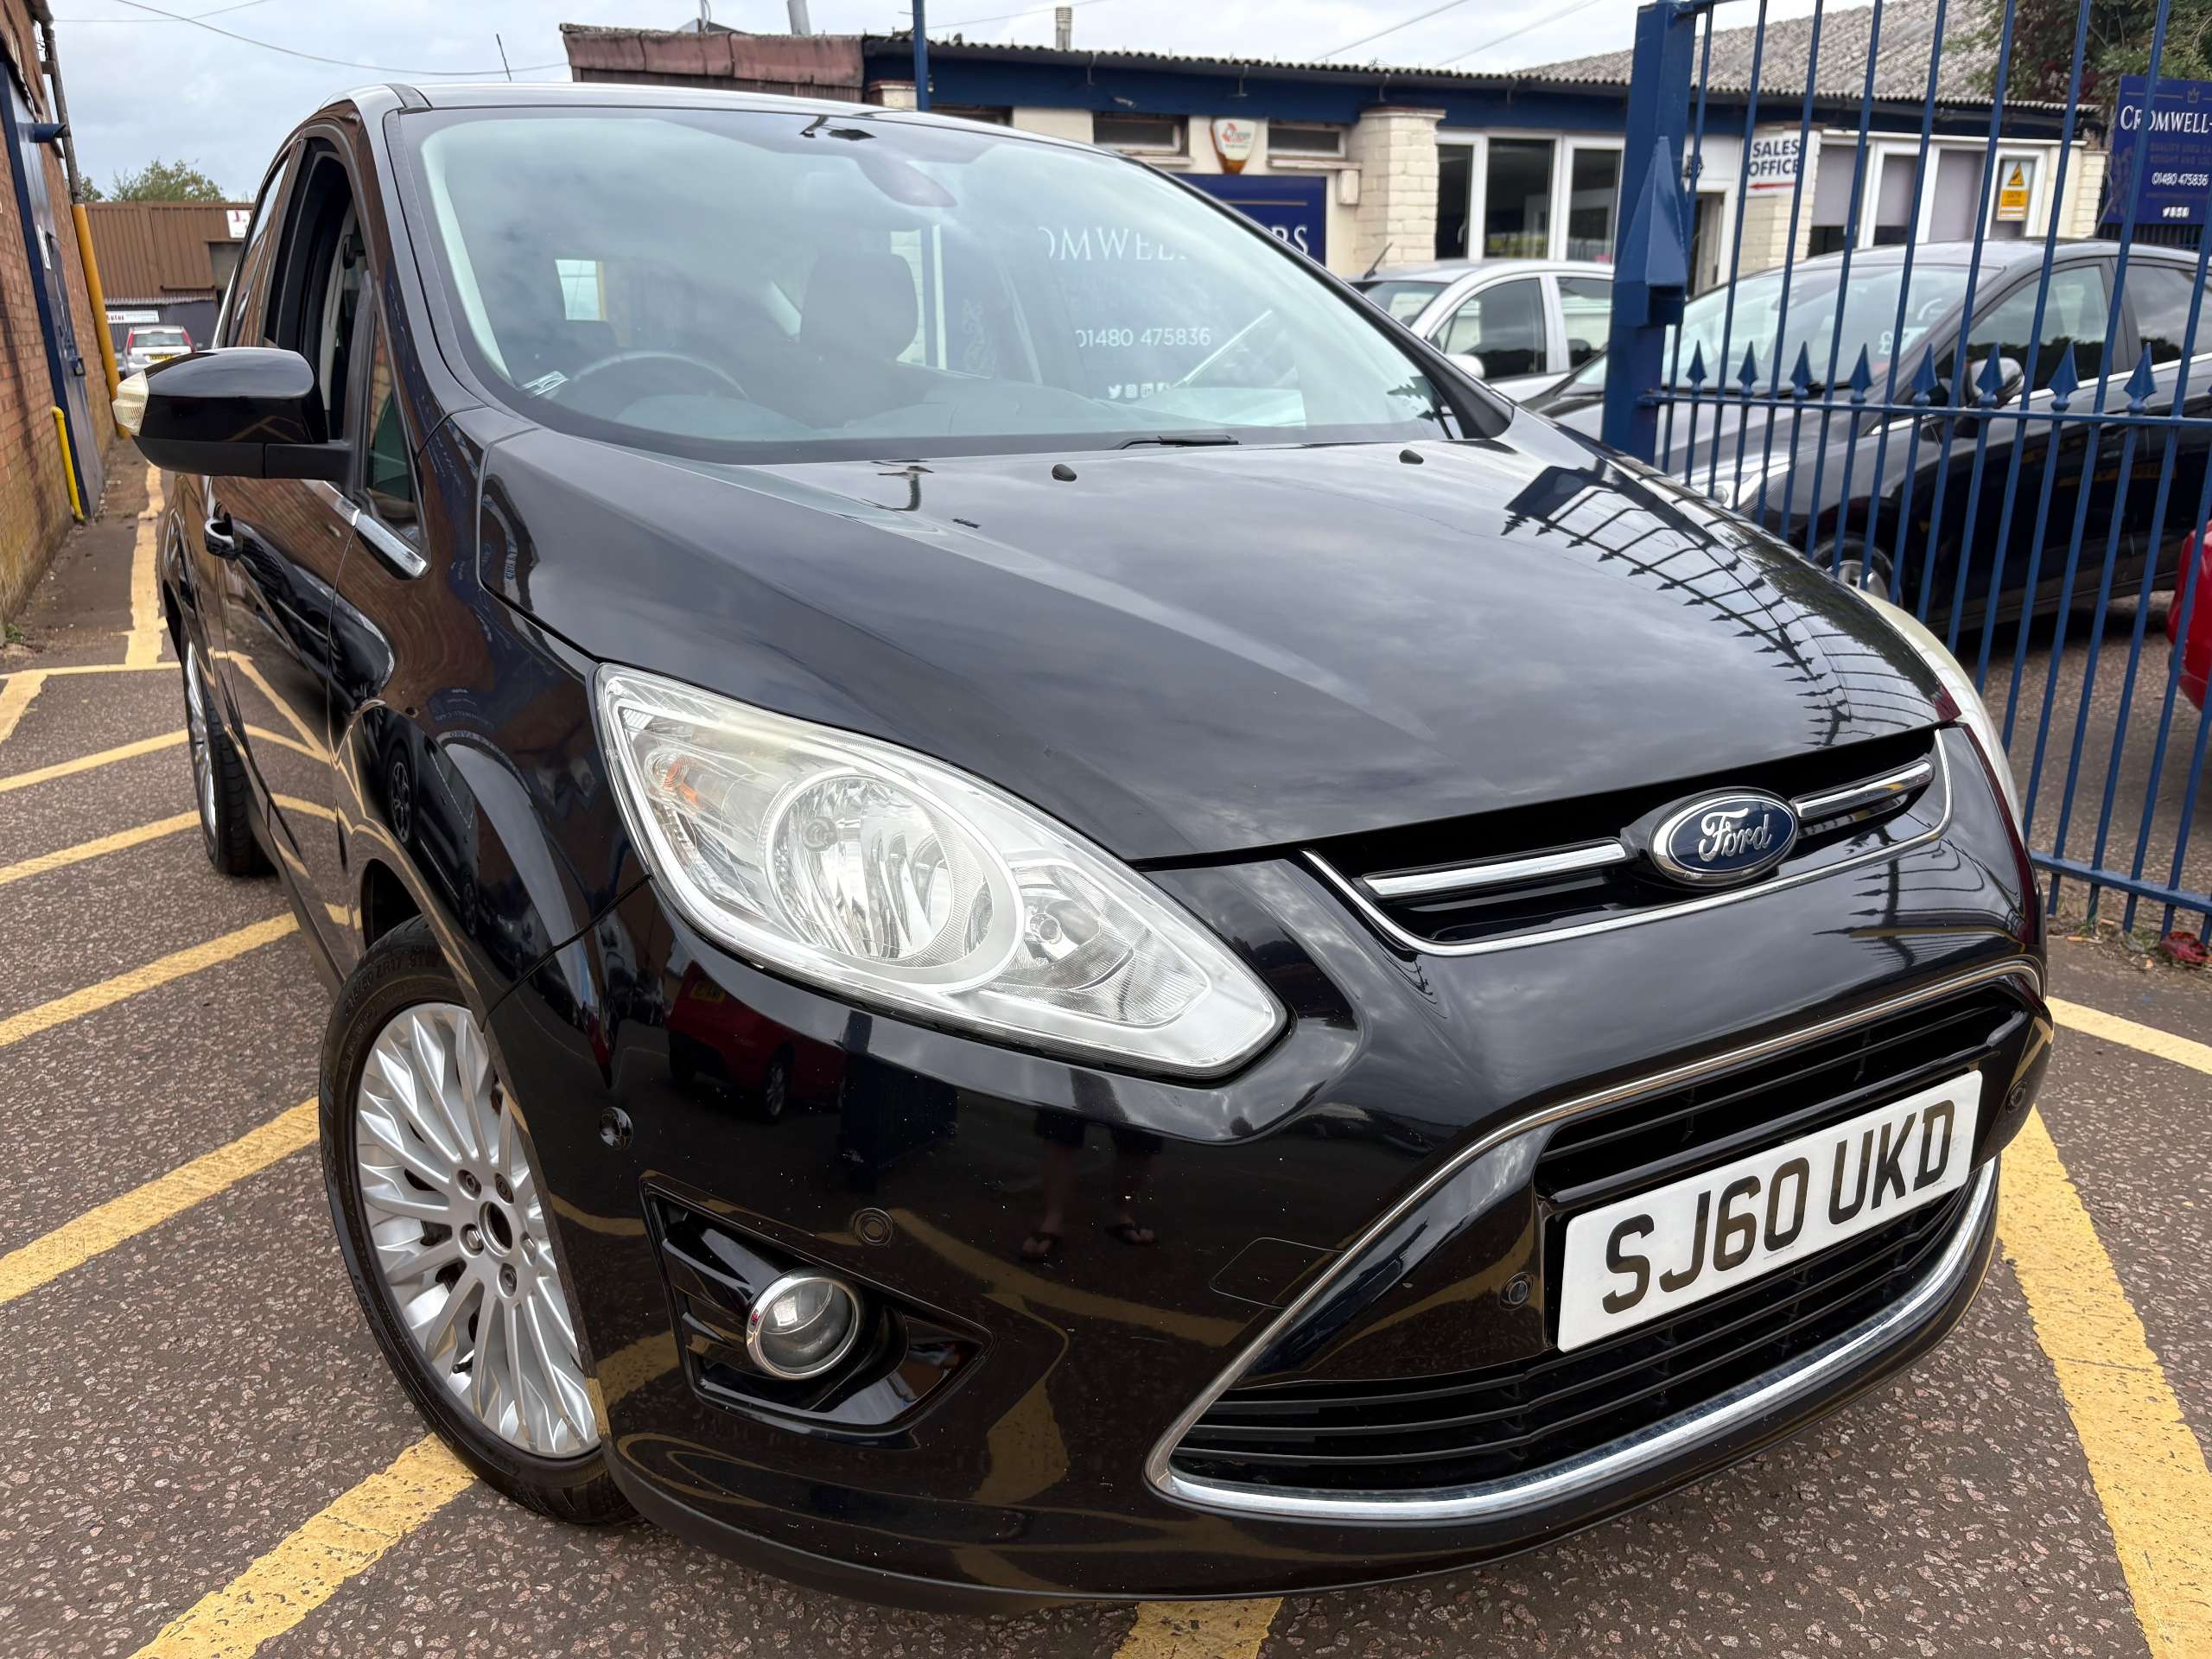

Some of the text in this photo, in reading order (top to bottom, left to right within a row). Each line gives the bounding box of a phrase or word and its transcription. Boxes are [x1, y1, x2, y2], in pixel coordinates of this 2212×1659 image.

[1752, 138, 1800, 157] SALES
[2152, 172, 2209, 186] 01480 475836
[1038, 226, 1187, 261] MWEL
[1076, 327, 1211, 347] 01480 475836
[1698, 807, 1773, 862] Ford
[1602, 1098, 1955, 1315] SJ60 UKD
